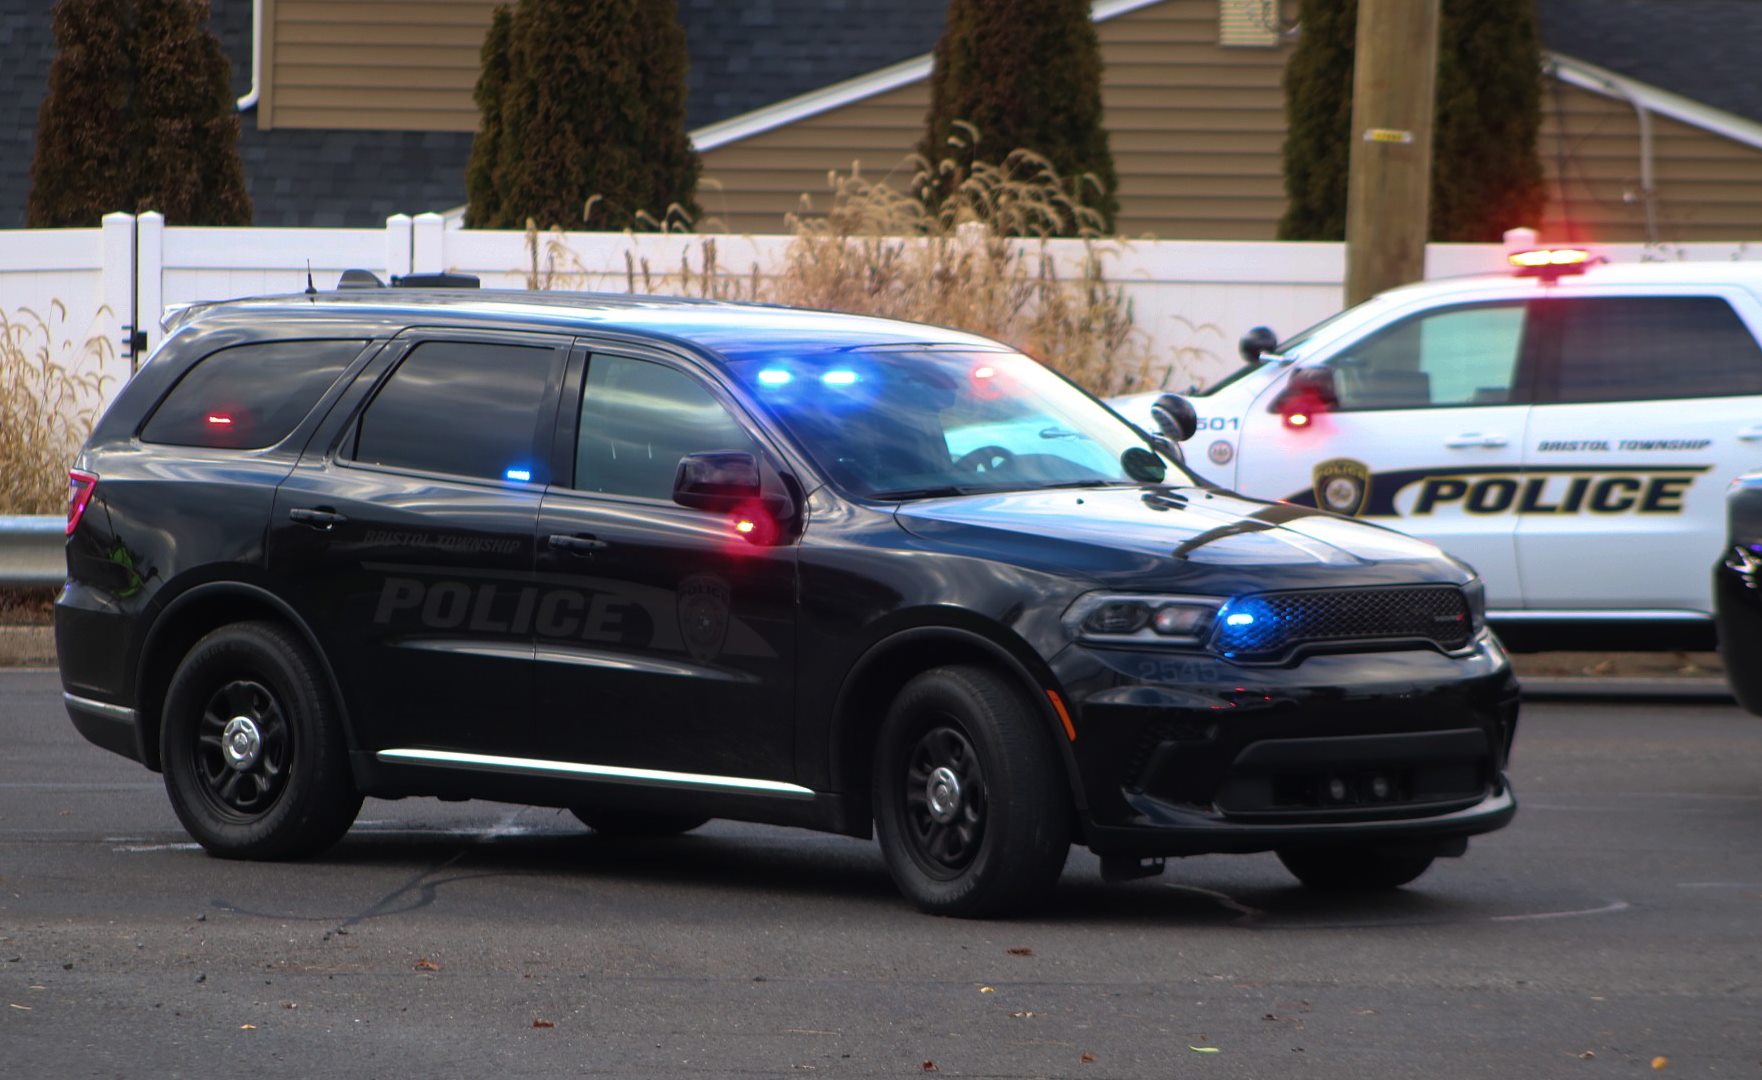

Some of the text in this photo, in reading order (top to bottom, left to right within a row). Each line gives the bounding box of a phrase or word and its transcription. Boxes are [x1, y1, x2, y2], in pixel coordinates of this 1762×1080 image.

[1536, 438, 1712, 451] BRISTOL TOWNSHIP
[1410, 475, 1694, 515] POLICE
[363, 529, 521, 553] BRISTOL TOWNSHIP
[373, 576, 624, 643] POLICE
[1138, 661, 1219, 681] 2545
